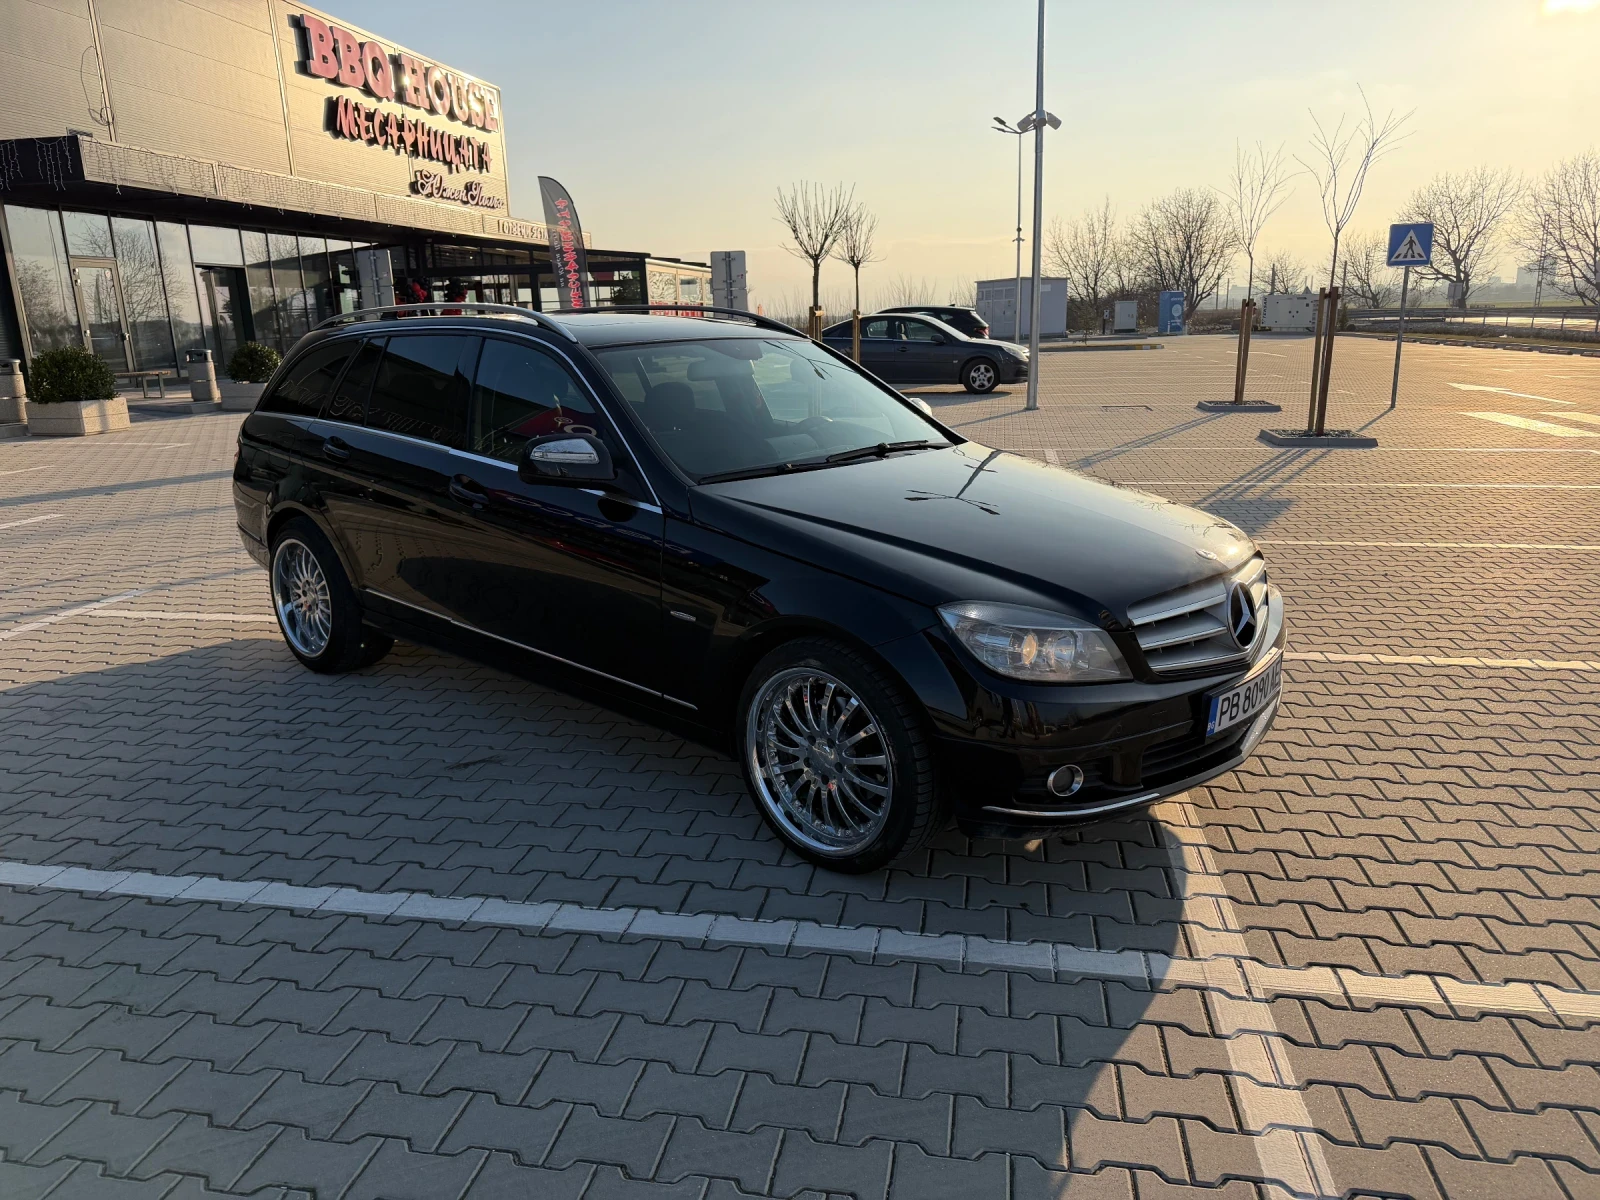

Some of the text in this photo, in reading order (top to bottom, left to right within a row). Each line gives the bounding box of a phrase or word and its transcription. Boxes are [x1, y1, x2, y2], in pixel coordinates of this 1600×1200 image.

[301, 14, 499, 132] BBQ HOUSE
[336, 95, 493, 174] МЕСАРНИЦАТА
[1218, 691, 1240, 727] PB
[1242, 671, 1270, 714] 8090
